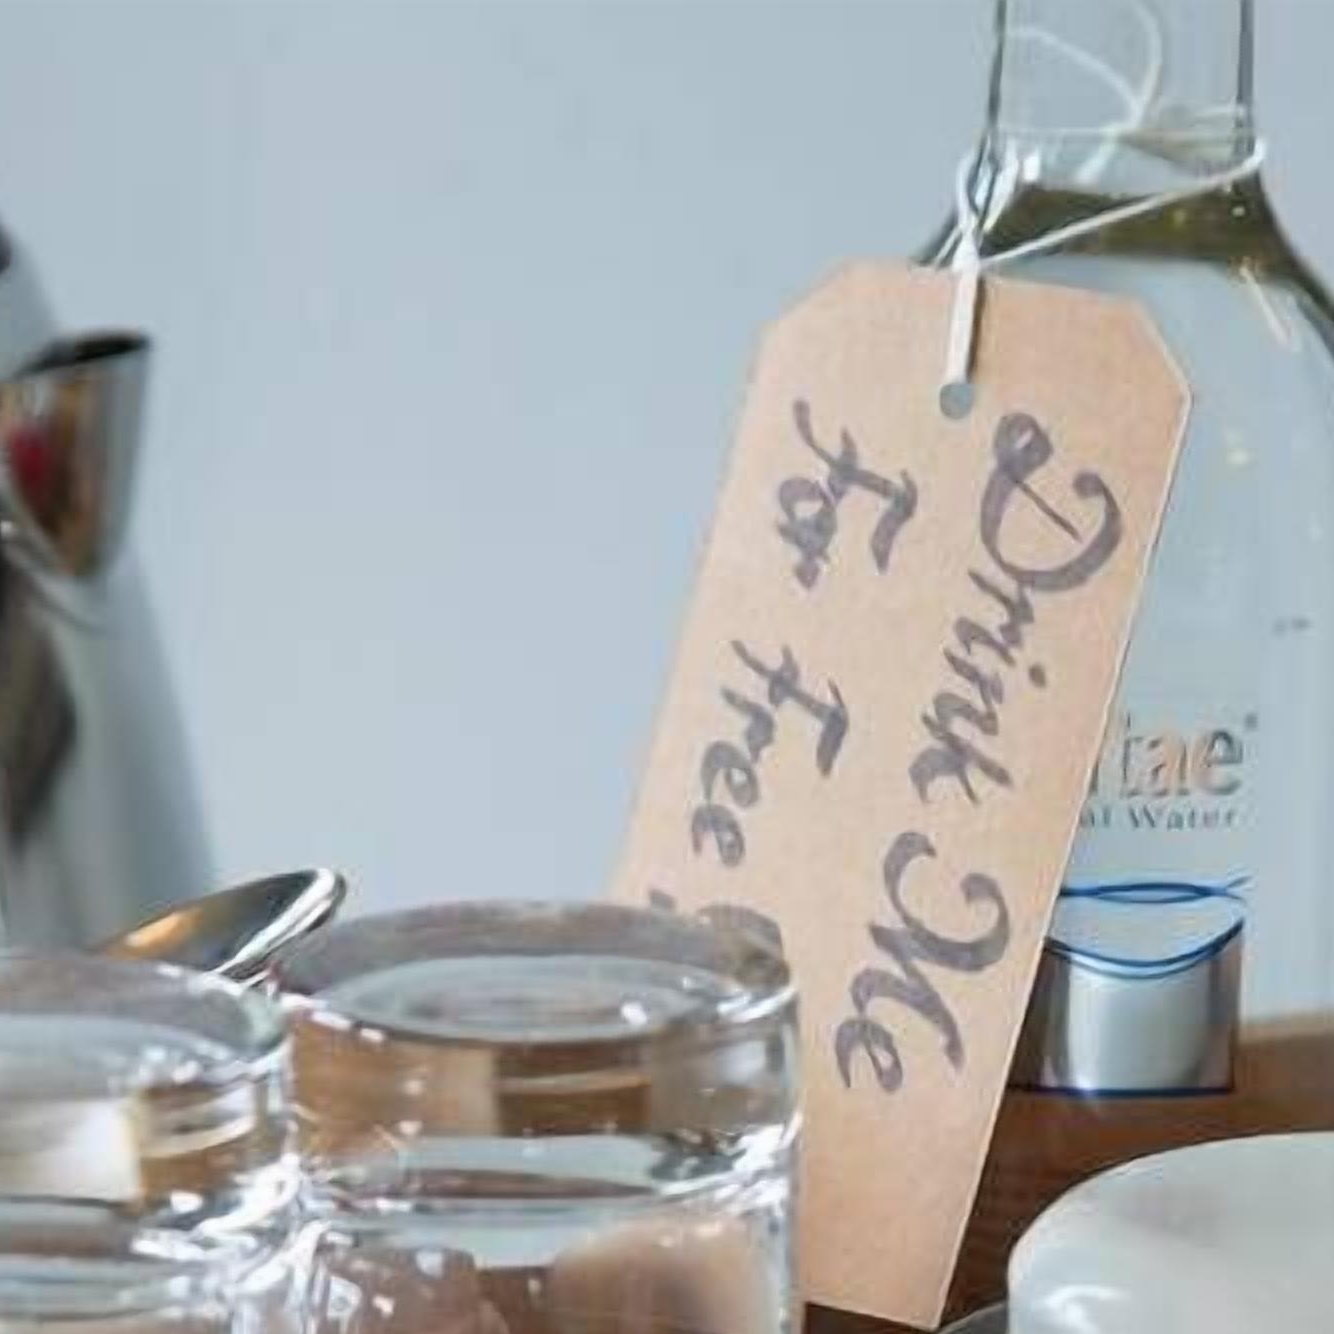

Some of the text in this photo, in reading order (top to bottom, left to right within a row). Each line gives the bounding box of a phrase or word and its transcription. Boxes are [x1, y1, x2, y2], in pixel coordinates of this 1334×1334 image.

[691, 400, 918, 867] for free
[834, 412, 1123, 1094] Drink Me
[1089, 712, 1244, 797] tae
[1127, 803, 1240, 831] Water
